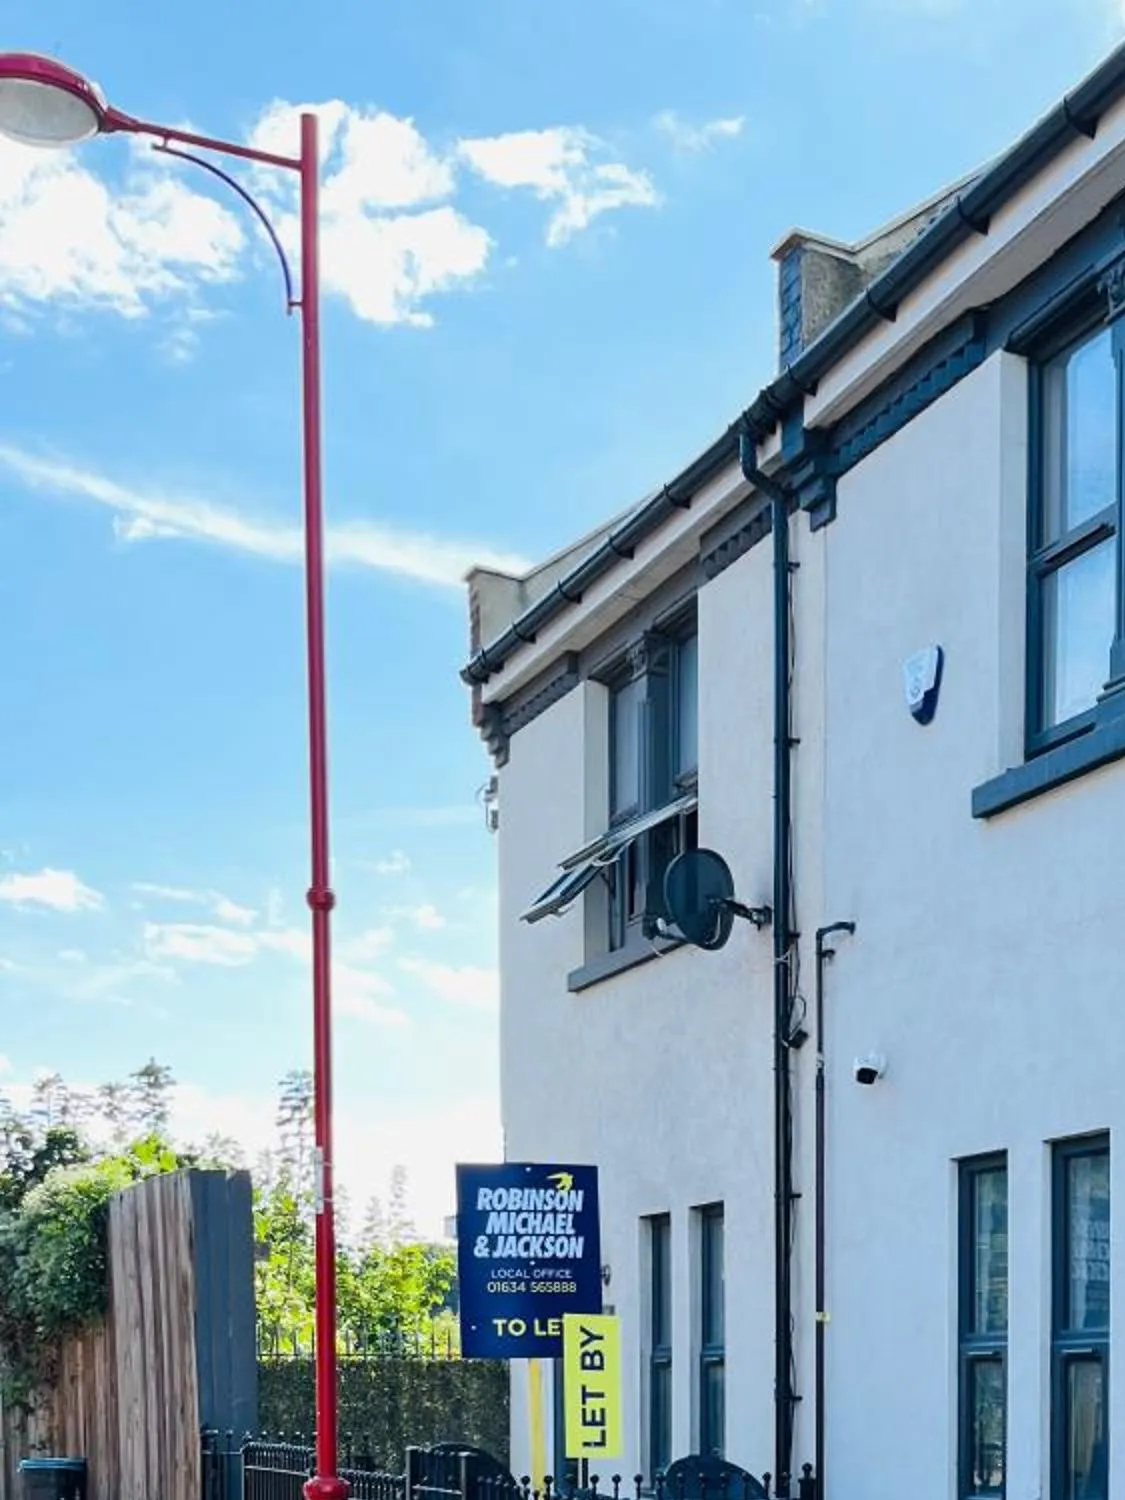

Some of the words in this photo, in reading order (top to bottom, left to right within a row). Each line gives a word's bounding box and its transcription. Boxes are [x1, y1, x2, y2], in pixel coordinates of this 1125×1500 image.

[477, 1187, 584, 1212] ROBINSON
[485, 1211, 576, 1235] MICHAEL
[473, 1235, 490, 1258] &
[492, 1236, 584, 1259] JACKSON
[491, 1269, 530, 1279] LOCAL
[533, 1269, 573, 1279] OFFICE
[487, 1282, 526, 1293] 01634
[530, 1282, 577, 1293] 565888
[492, 1318, 526, 1337] TO
[534, 1318, 565, 1337] LE
[579, 1325, 605, 1371] BY
[580, 1384, 606, 1448] LET
